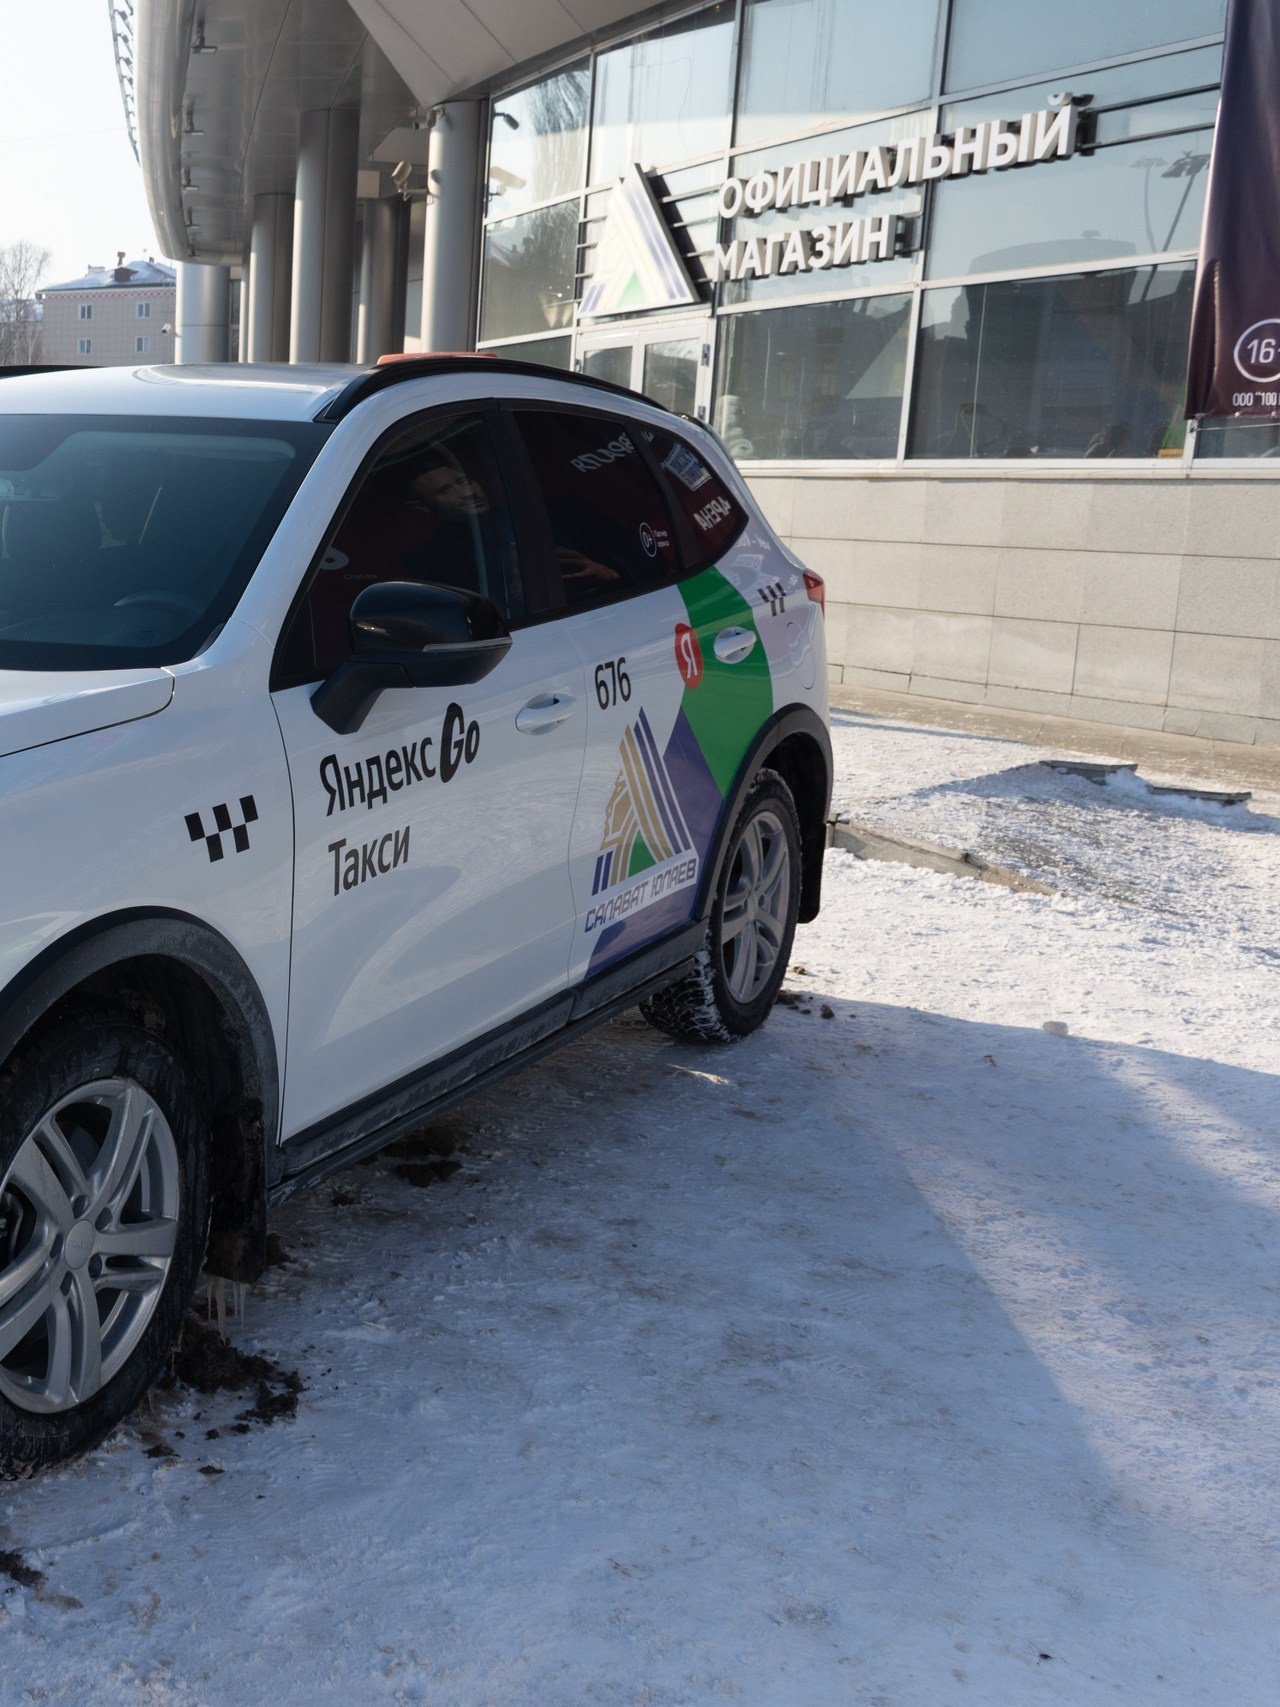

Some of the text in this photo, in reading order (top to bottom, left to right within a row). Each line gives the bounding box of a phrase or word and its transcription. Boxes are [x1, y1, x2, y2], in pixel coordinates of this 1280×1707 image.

[720, 92, 1083, 220] ОФИЦИАЛЬНЫЙ
[715, 214, 891, 282] МАГАЗИН
[1232, 392, 1254, 406] ООО
[595, 657, 632, 710] 676
[681, 632, 699, 679] Я
[320, 702, 480, 817] Яндекс Go
[327, 825, 411, 897] Такси
[584, 857, 697, 934] САЛАВАТ ЮЛАЕВ
